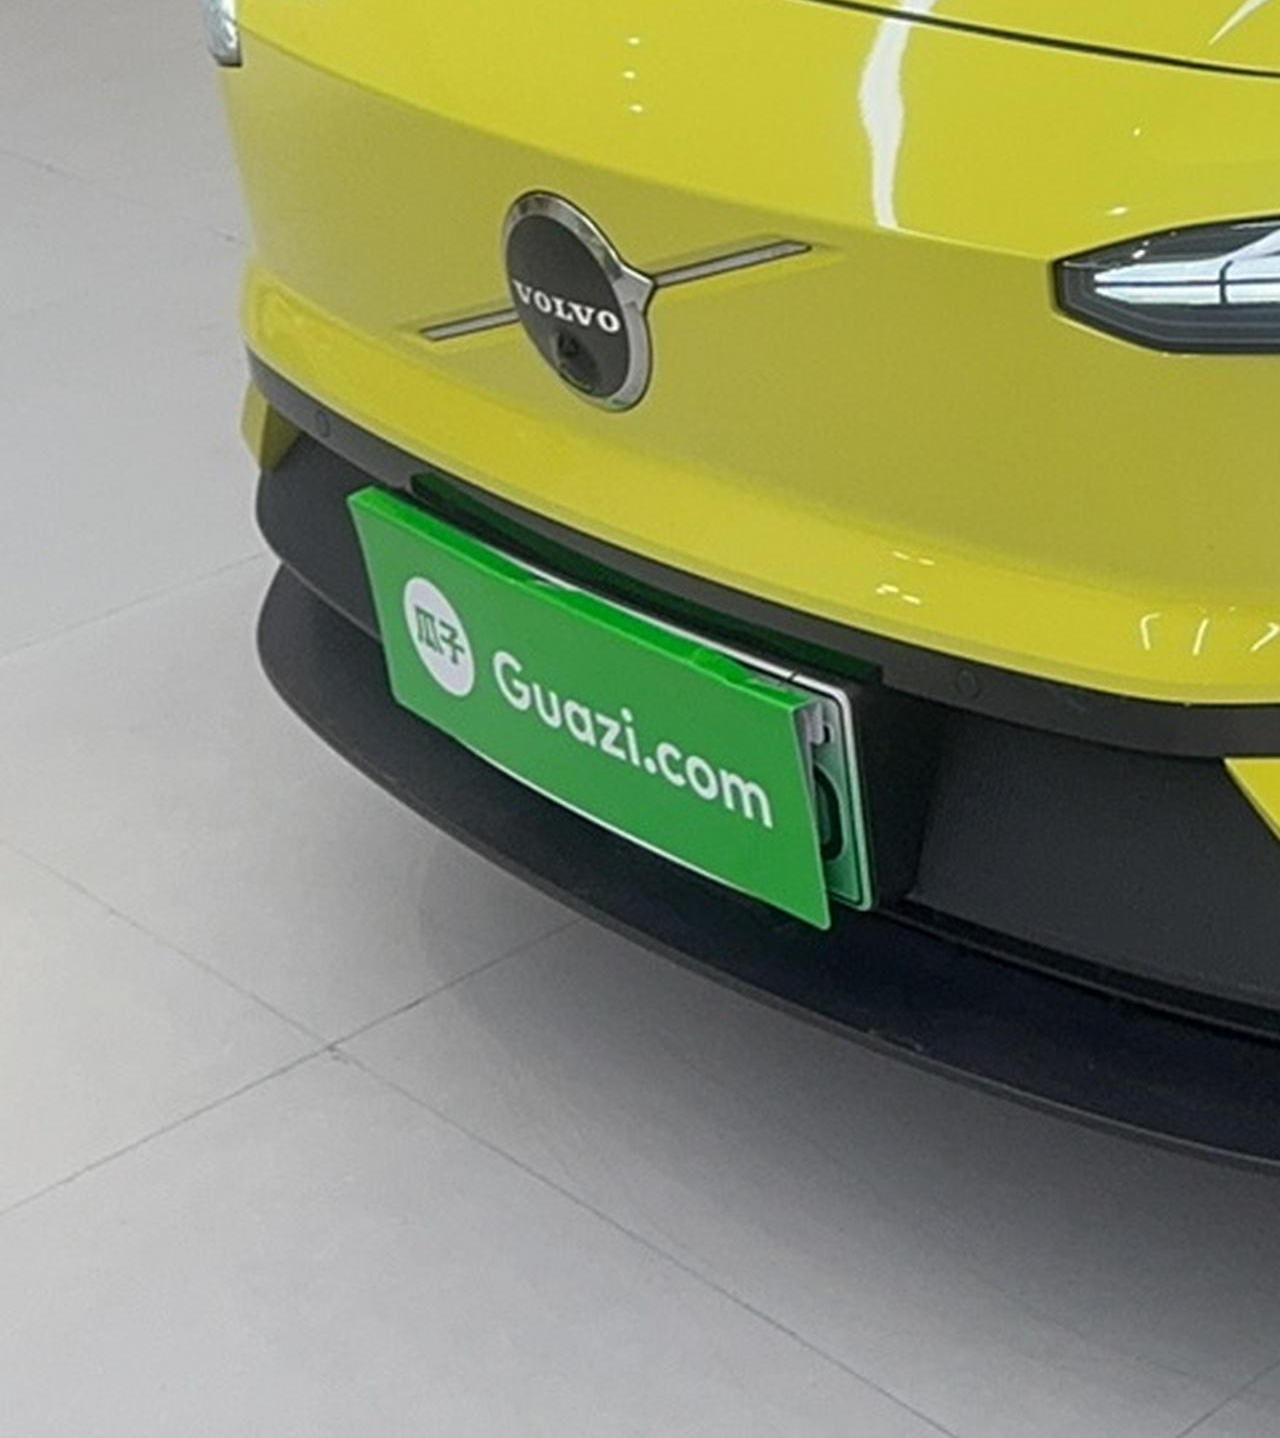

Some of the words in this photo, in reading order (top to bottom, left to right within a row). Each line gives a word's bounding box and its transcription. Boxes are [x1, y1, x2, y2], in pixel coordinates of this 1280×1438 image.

[513, 279, 621, 334] VOLVO
[413, 603, 466, 666] 瓜子
[492, 650, 774, 830] Guazi.com
